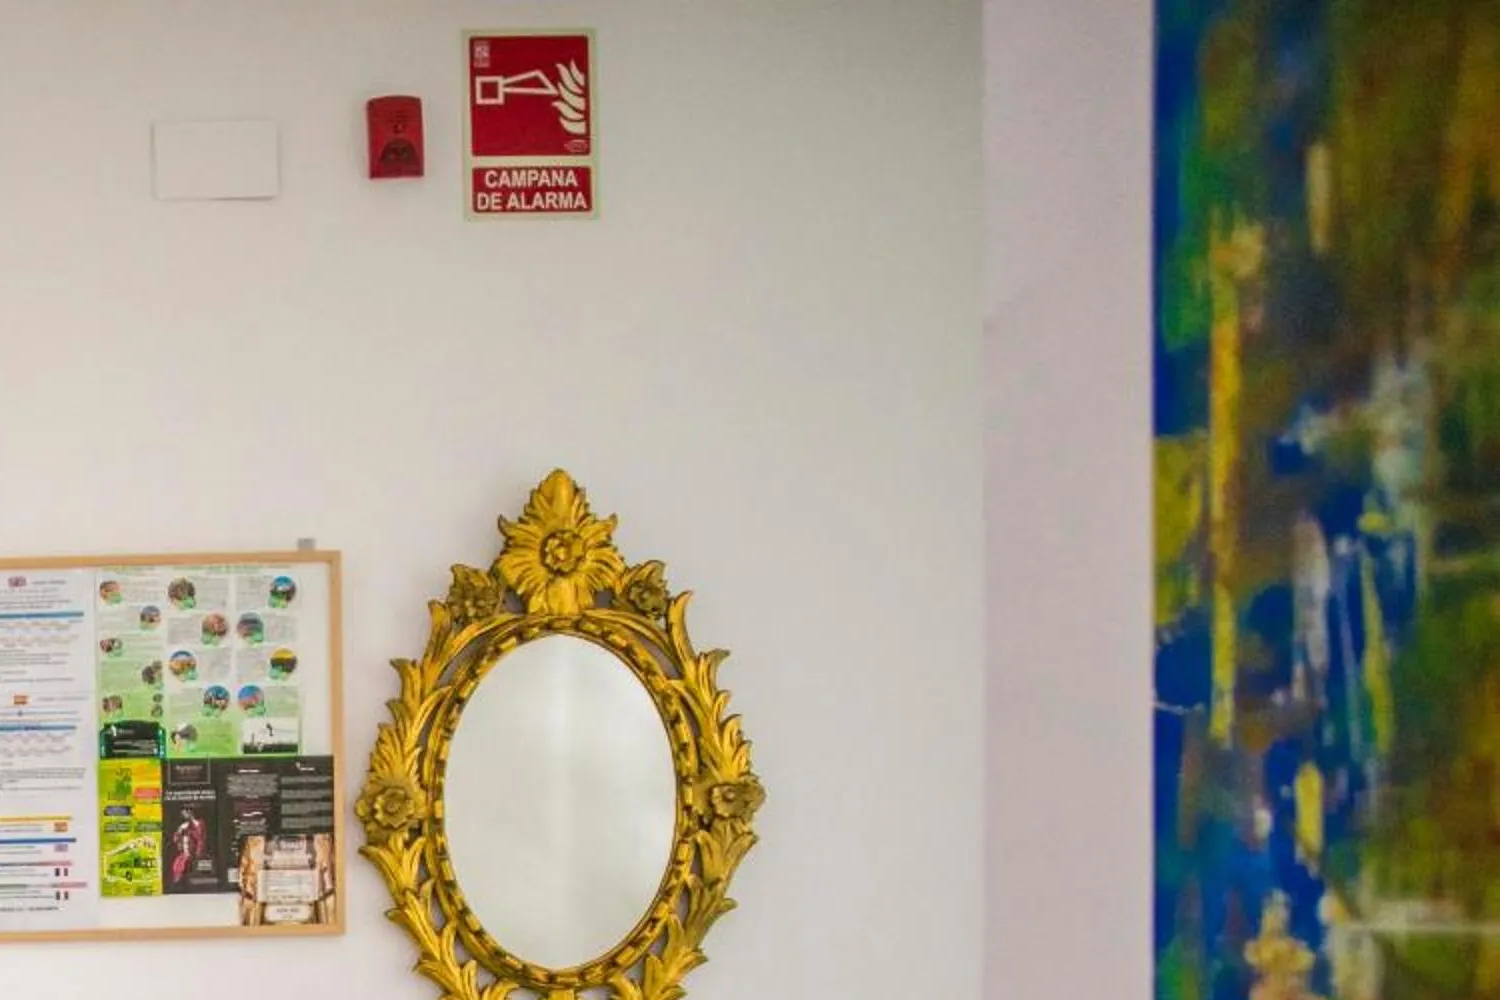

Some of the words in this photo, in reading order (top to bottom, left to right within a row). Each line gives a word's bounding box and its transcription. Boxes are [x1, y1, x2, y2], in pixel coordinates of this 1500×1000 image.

[484, 168, 578, 189] CAMPANA
[476, 191, 503, 211] DE
[506, 190, 588, 210] ALARMA
